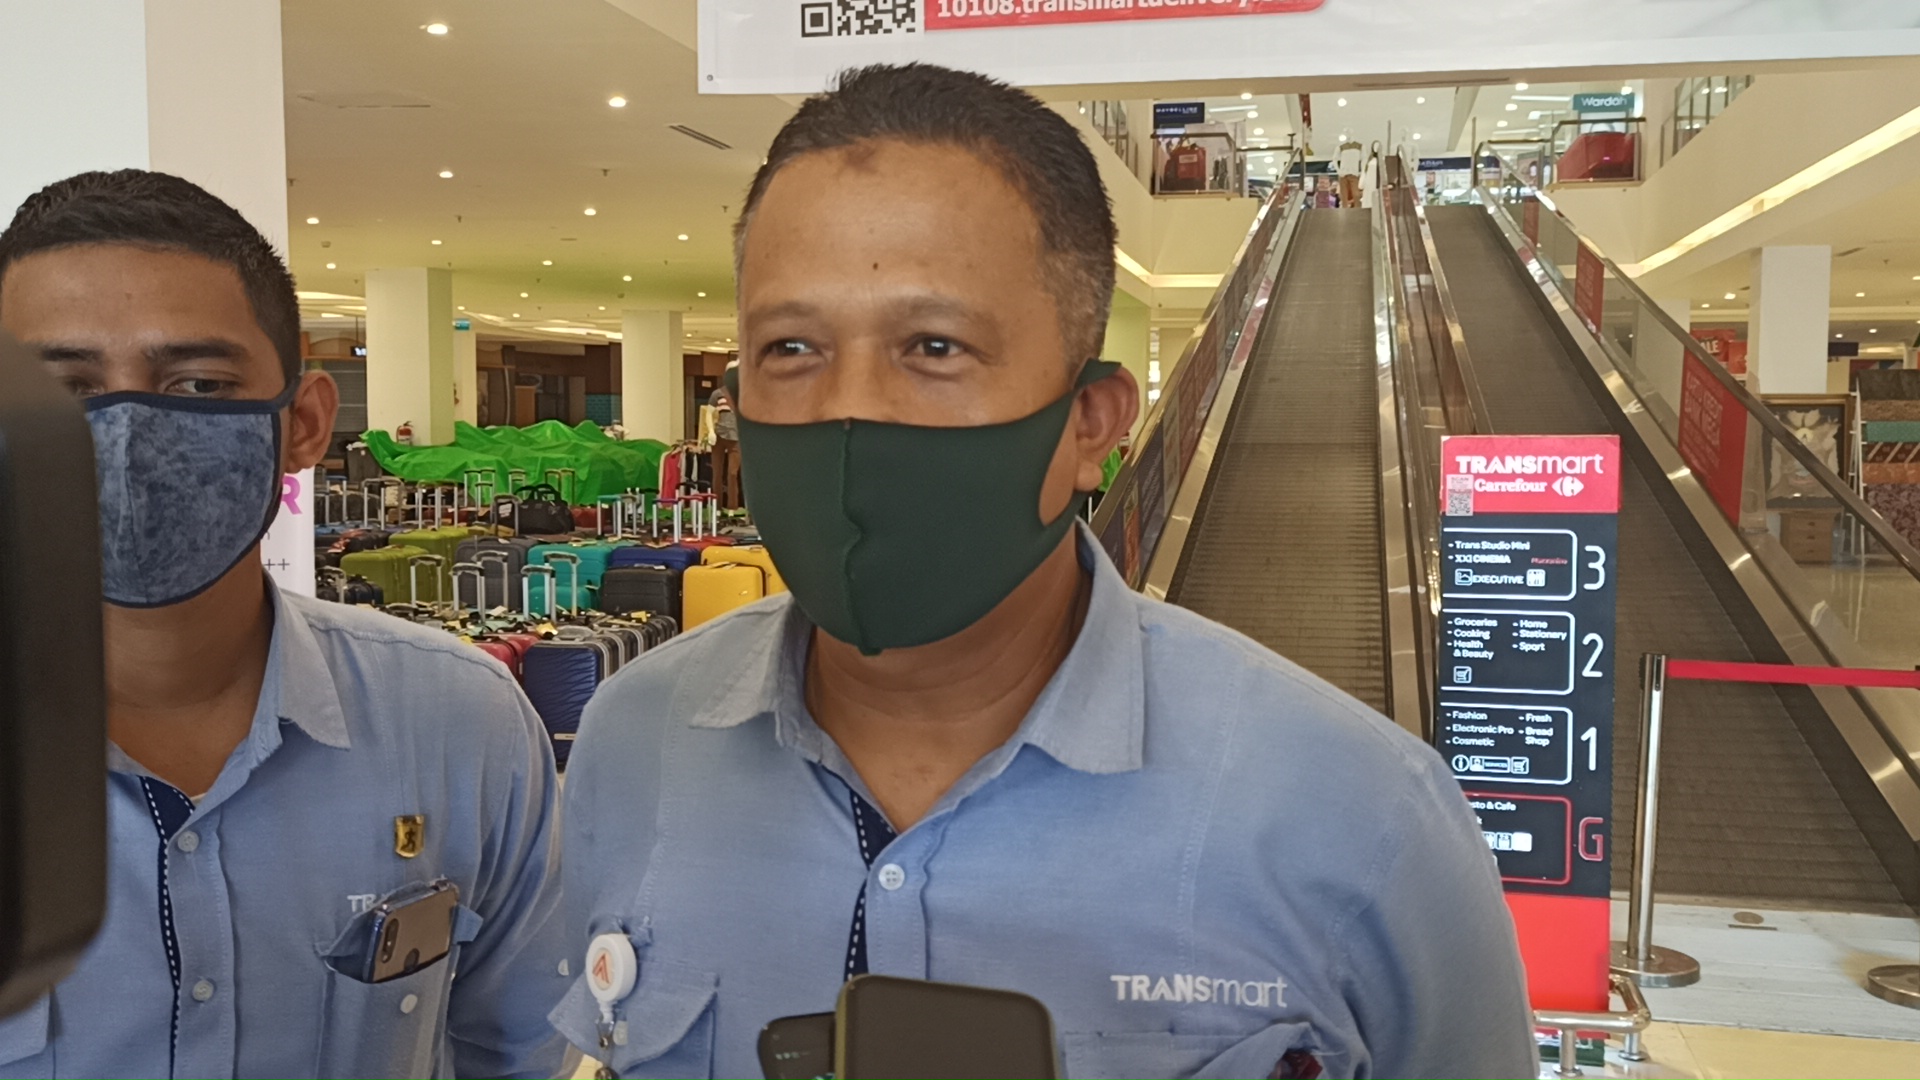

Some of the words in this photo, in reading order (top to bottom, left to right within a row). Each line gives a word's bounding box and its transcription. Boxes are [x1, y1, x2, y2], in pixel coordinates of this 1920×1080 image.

[1581, 96, 1627, 106] Wardah
[1455, 454, 1604, 474] TRANSmart
[1474, 478, 1548, 492] Carrefour
[1455, 541, 1480, 550] Trans
[1481, 541, 1510, 550] Studio
[1511, 541, 1530, 550] Mini
[1473, 555, 1511, 564] CINEMA
[1583, 545, 1606, 590] 3
[1473, 575, 1524, 584] EXECUTIVE
[1454, 618, 1498, 627] Groceries
[1519, 620, 1548, 629] Home
[1454, 629, 1491, 640] Cooking
[1453, 640, 1483, 649] Health
[1519, 642, 1545, 652] Sport
[1453, 649, 1461, 657] &
[1462, 649, 1494, 660] Beauty
[1582, 632, 1604, 677] 2
[1452, 711, 1488, 720] Fashion
[1525, 713, 1552, 722] Fresh
[1452, 724, 1497, 734] Electronic
[1498, 725, 1514, 735] Pro
[1525, 727, 1553, 736] Bread
[1452, 736, 1495, 746] Cosmetic
[1525, 736, 1550, 747] Shop
[1581, 727, 1597, 771] 1
[1486, 801, 1494, 810] &
[1495, 801, 1516, 811] Cafe
[1578, 816, 1604, 861] G
[1110, 973, 1288, 1008] TRANSmart
